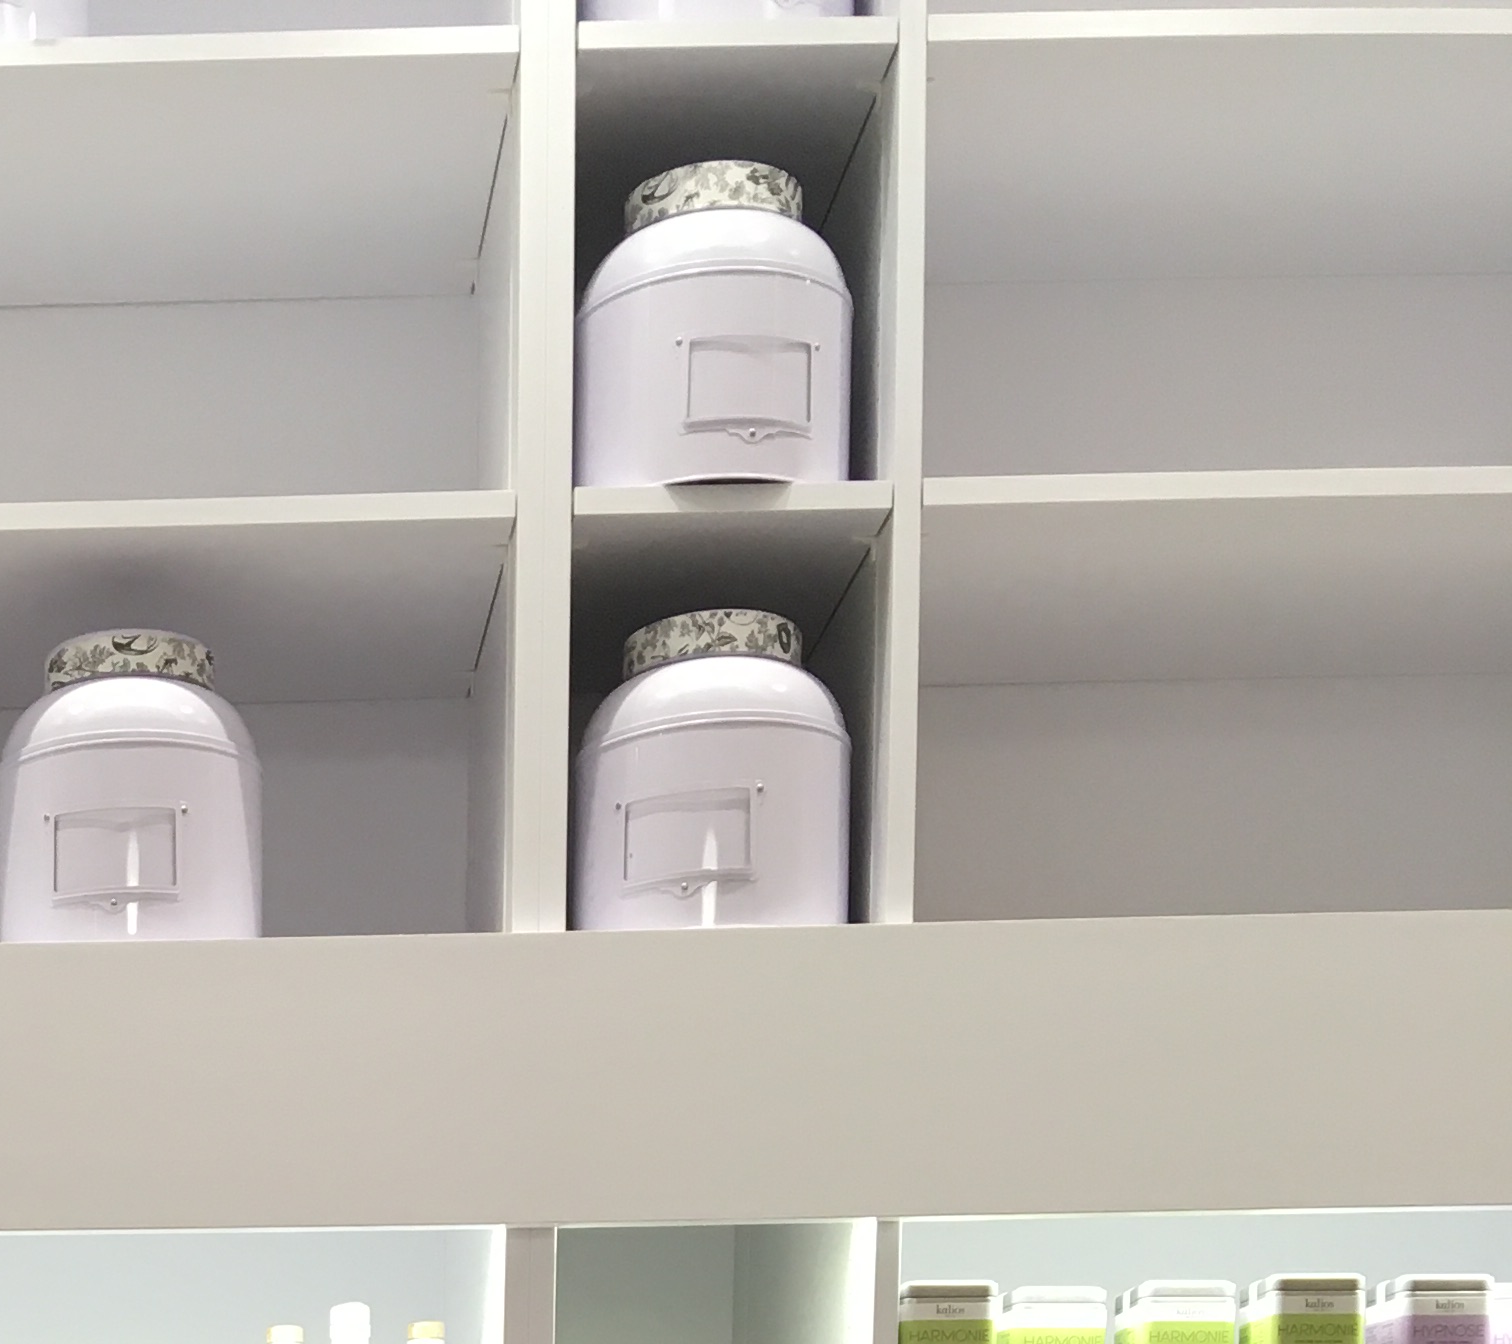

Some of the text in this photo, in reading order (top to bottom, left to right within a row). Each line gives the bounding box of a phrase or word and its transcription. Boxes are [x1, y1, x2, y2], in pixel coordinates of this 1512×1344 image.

[908, 1329, 991, 1342] HARMONIE
[1277, 1322, 1359, 1337] HARMONIE
[1412, 1323, 1485, 1338] HYPNOSE
[1148, 1330, 1229, 1344] HARMONIE
